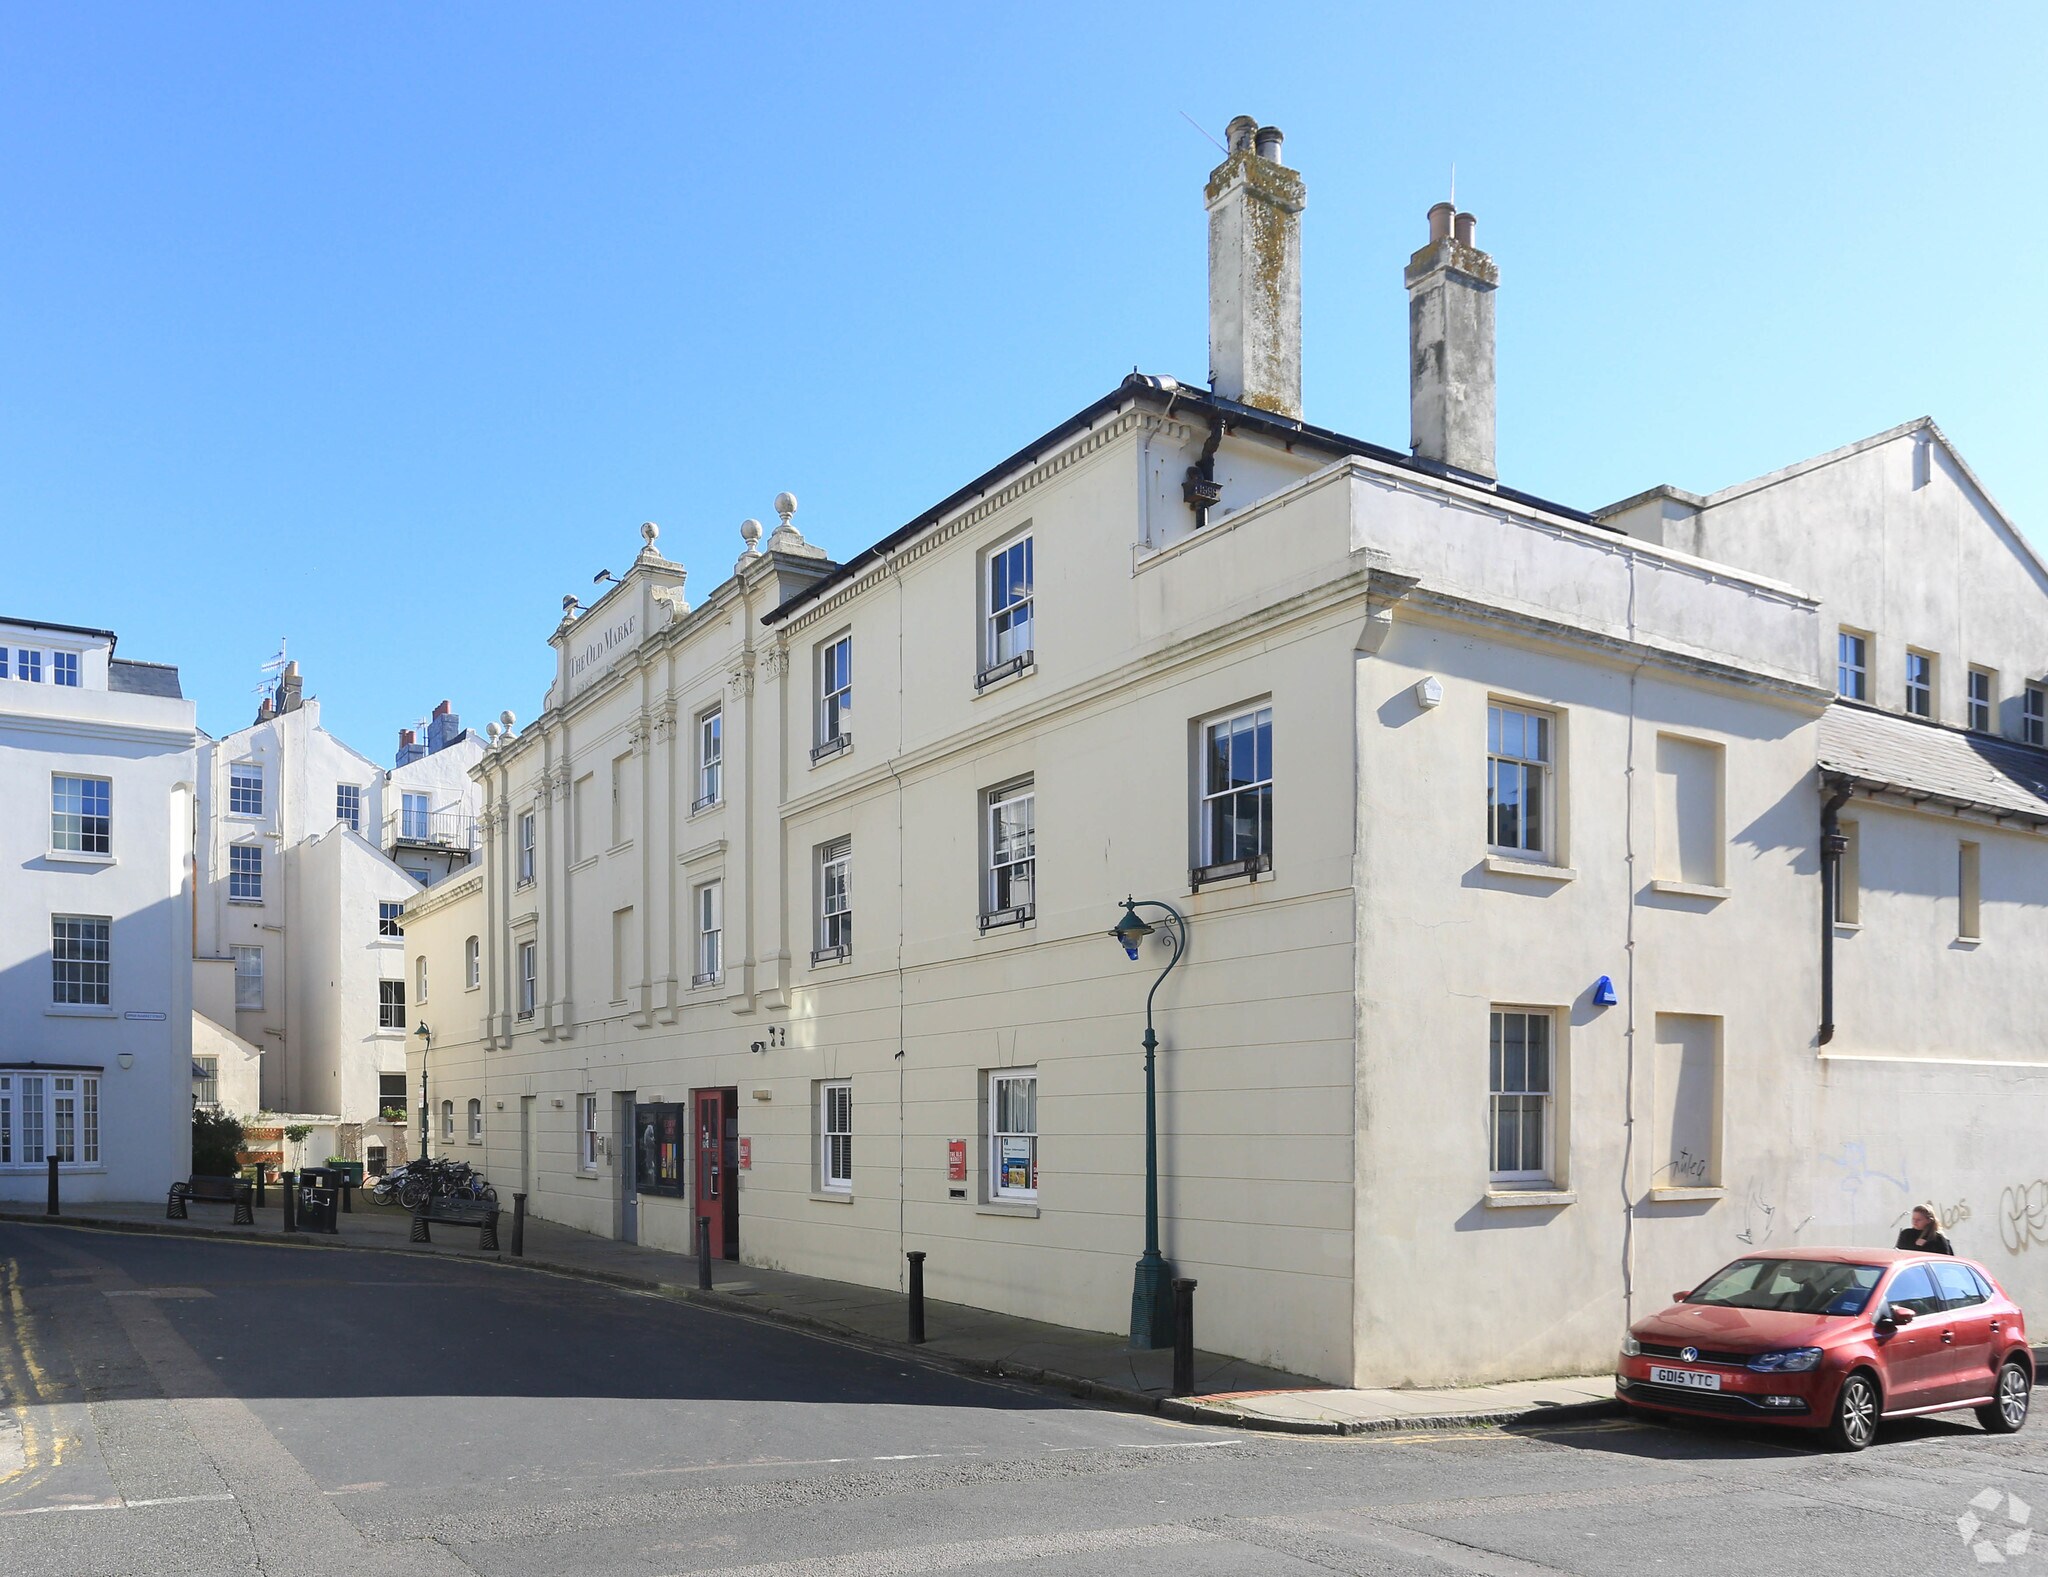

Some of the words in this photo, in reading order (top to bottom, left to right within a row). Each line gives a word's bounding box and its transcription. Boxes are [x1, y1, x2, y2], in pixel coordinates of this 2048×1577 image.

[569, 654, 585, 678] THE
[586, 641, 603, 666] OLD
[1658, 1369, 1685, 1383] GD15
[1689, 1373, 1713, 1387] YTC
